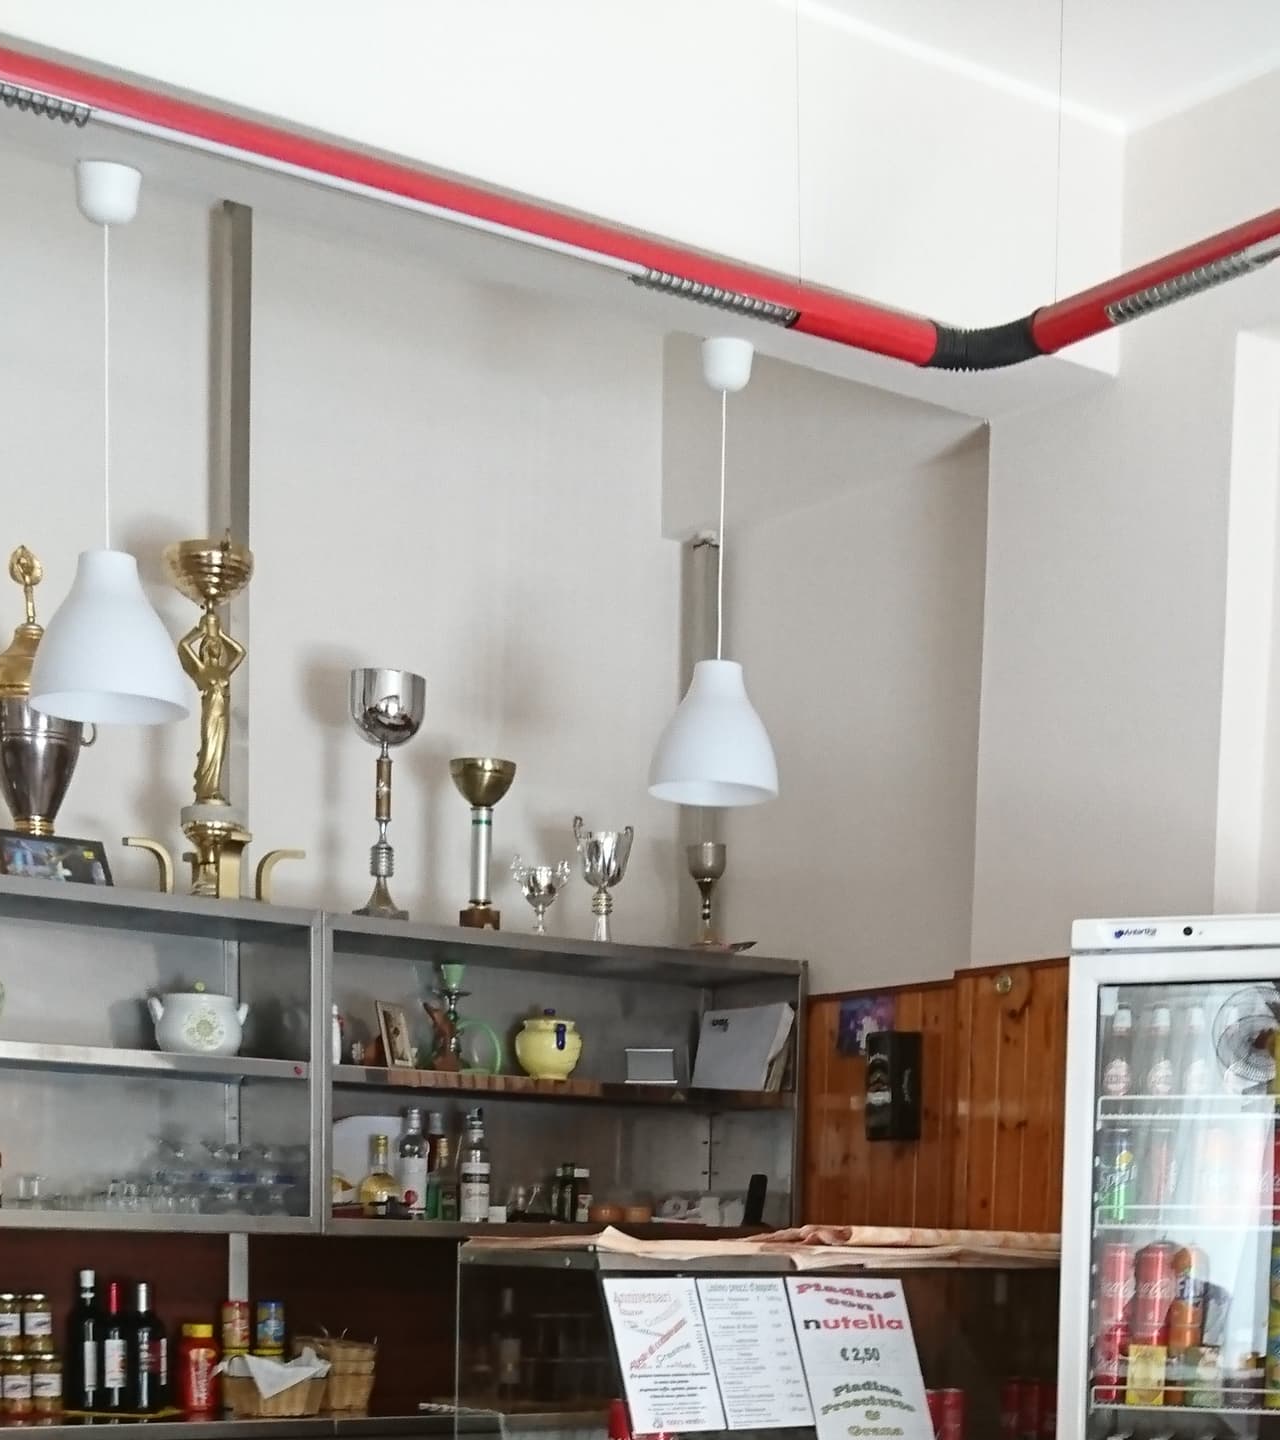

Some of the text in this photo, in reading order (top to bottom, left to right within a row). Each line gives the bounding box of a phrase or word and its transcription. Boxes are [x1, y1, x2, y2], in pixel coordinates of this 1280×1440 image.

[796, 1283, 897, 1299] Piadina
[803, 1313, 905, 1330] nutella
[840, 1347, 880, 1363] € 2,50
[833, 1381, 903, 1397] Piadina
